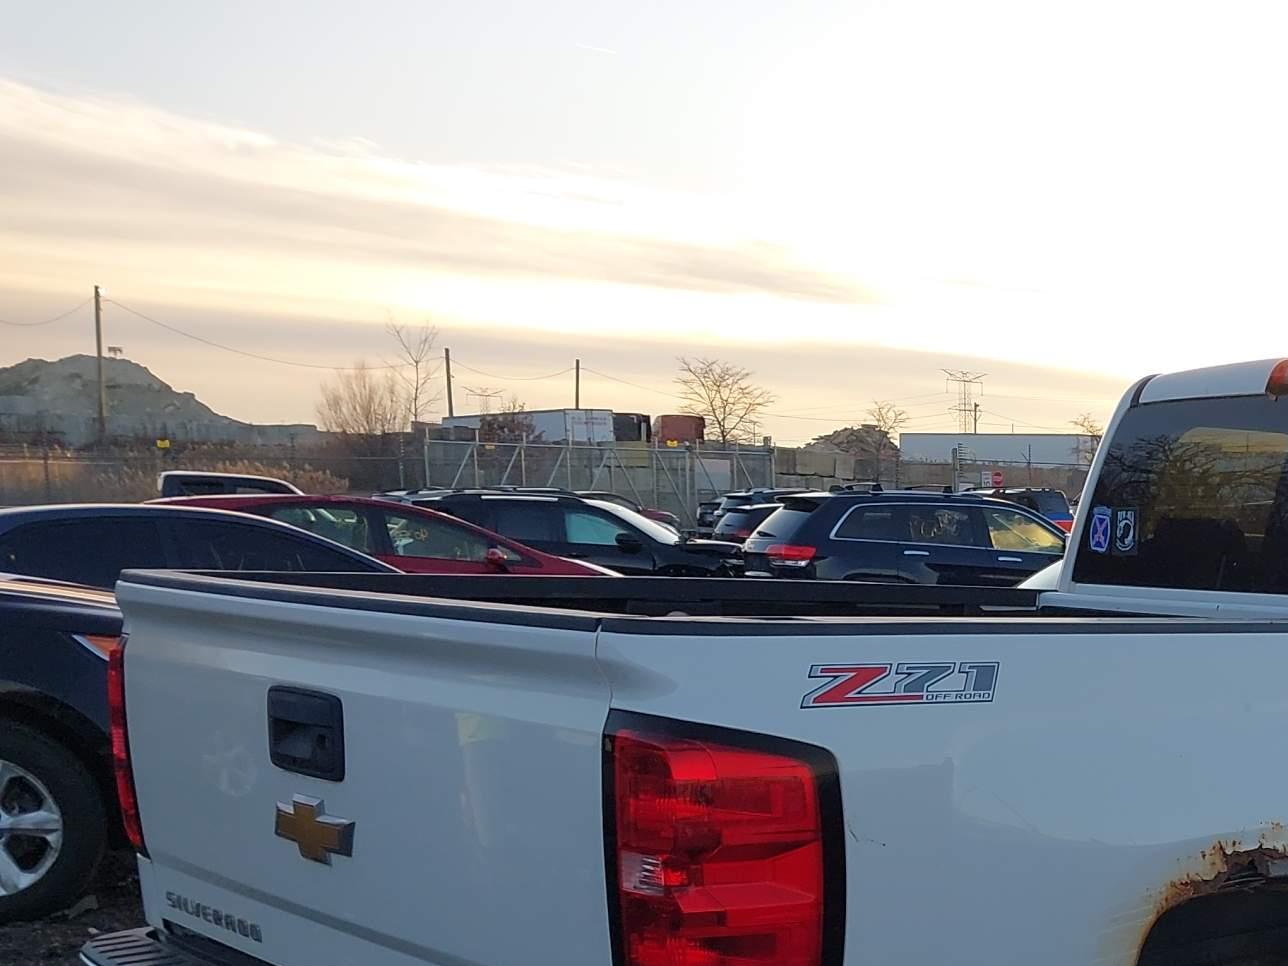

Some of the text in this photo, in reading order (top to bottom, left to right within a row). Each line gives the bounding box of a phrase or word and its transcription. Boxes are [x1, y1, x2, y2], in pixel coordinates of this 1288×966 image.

[800, 661, 999, 709] Z71
[926, 692, 991, 701] OFF ROAD
[165, 891, 263, 943] SILVERADO
